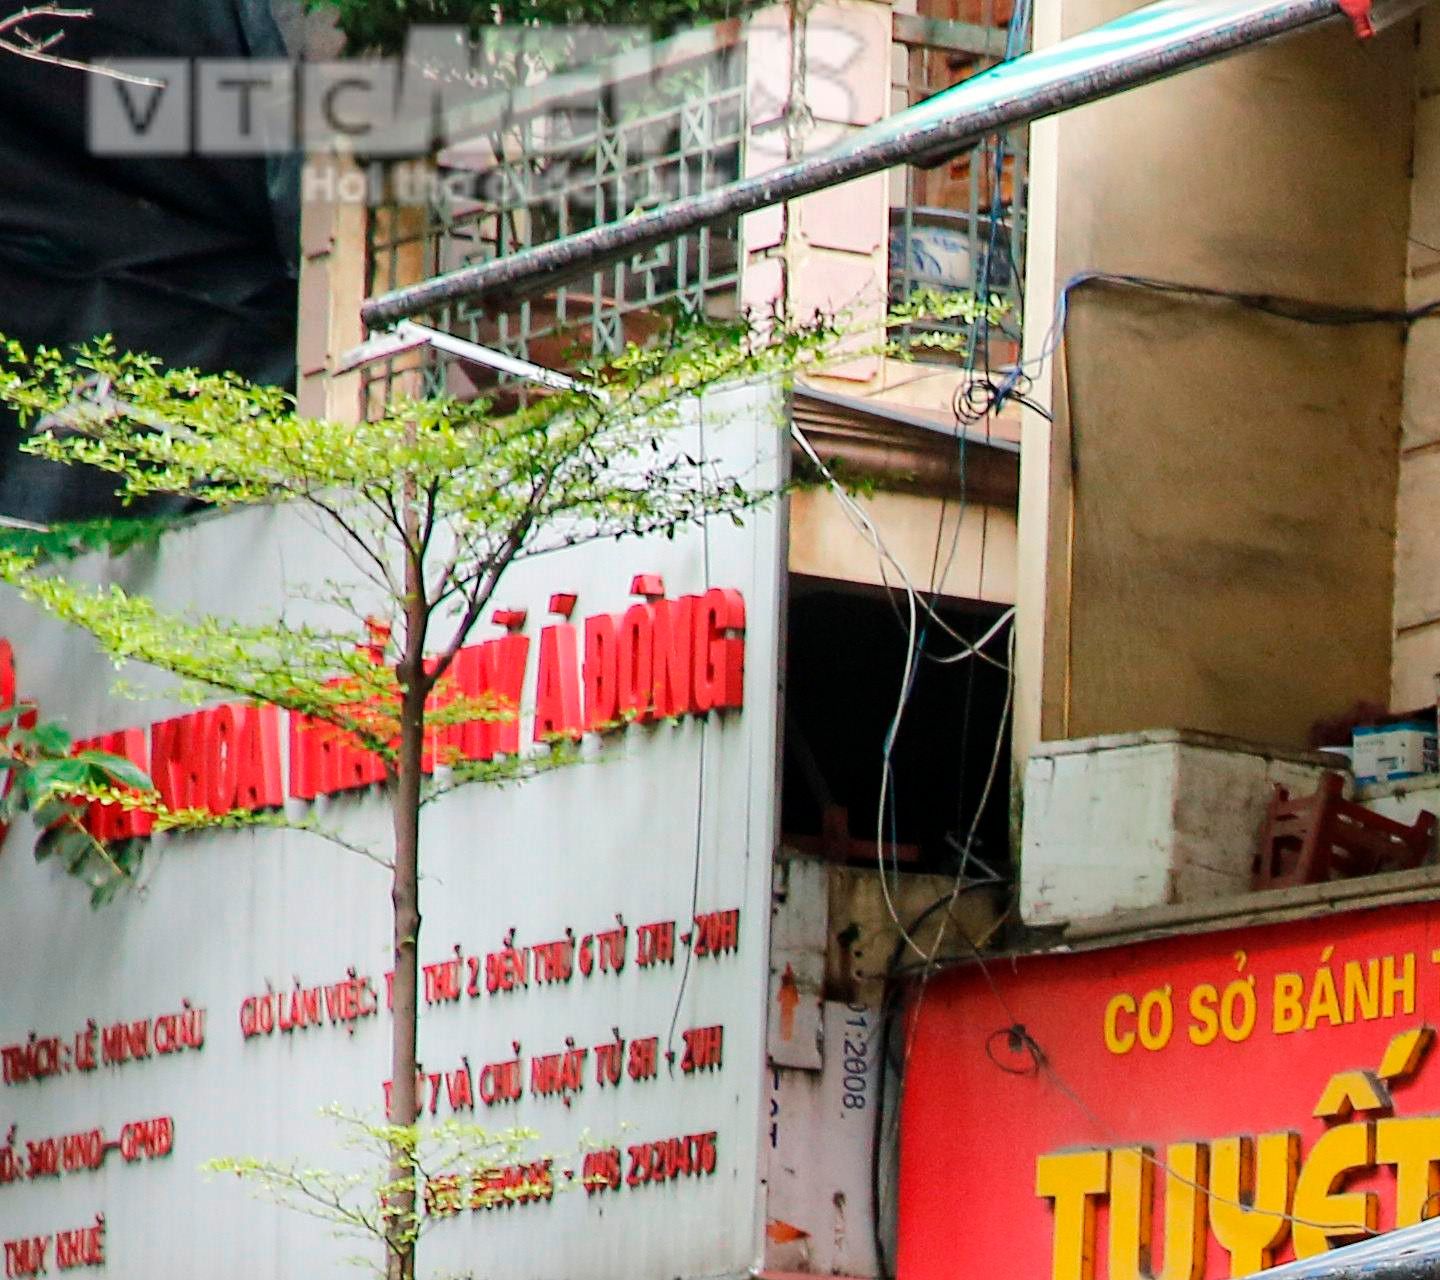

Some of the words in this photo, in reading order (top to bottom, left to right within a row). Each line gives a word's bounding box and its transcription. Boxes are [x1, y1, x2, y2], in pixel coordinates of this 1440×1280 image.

[101, 1016, 152, 1068] MINH
[154, 998, 207, 1054] CHÂU
[1104, 976, 1174, 1055] CƠ
[1188, 949, 1259, 1047] SỞ
[1274, 945, 1417, 1035] BÁNH
[56, 1213, 107, 1273] KHUÊ
